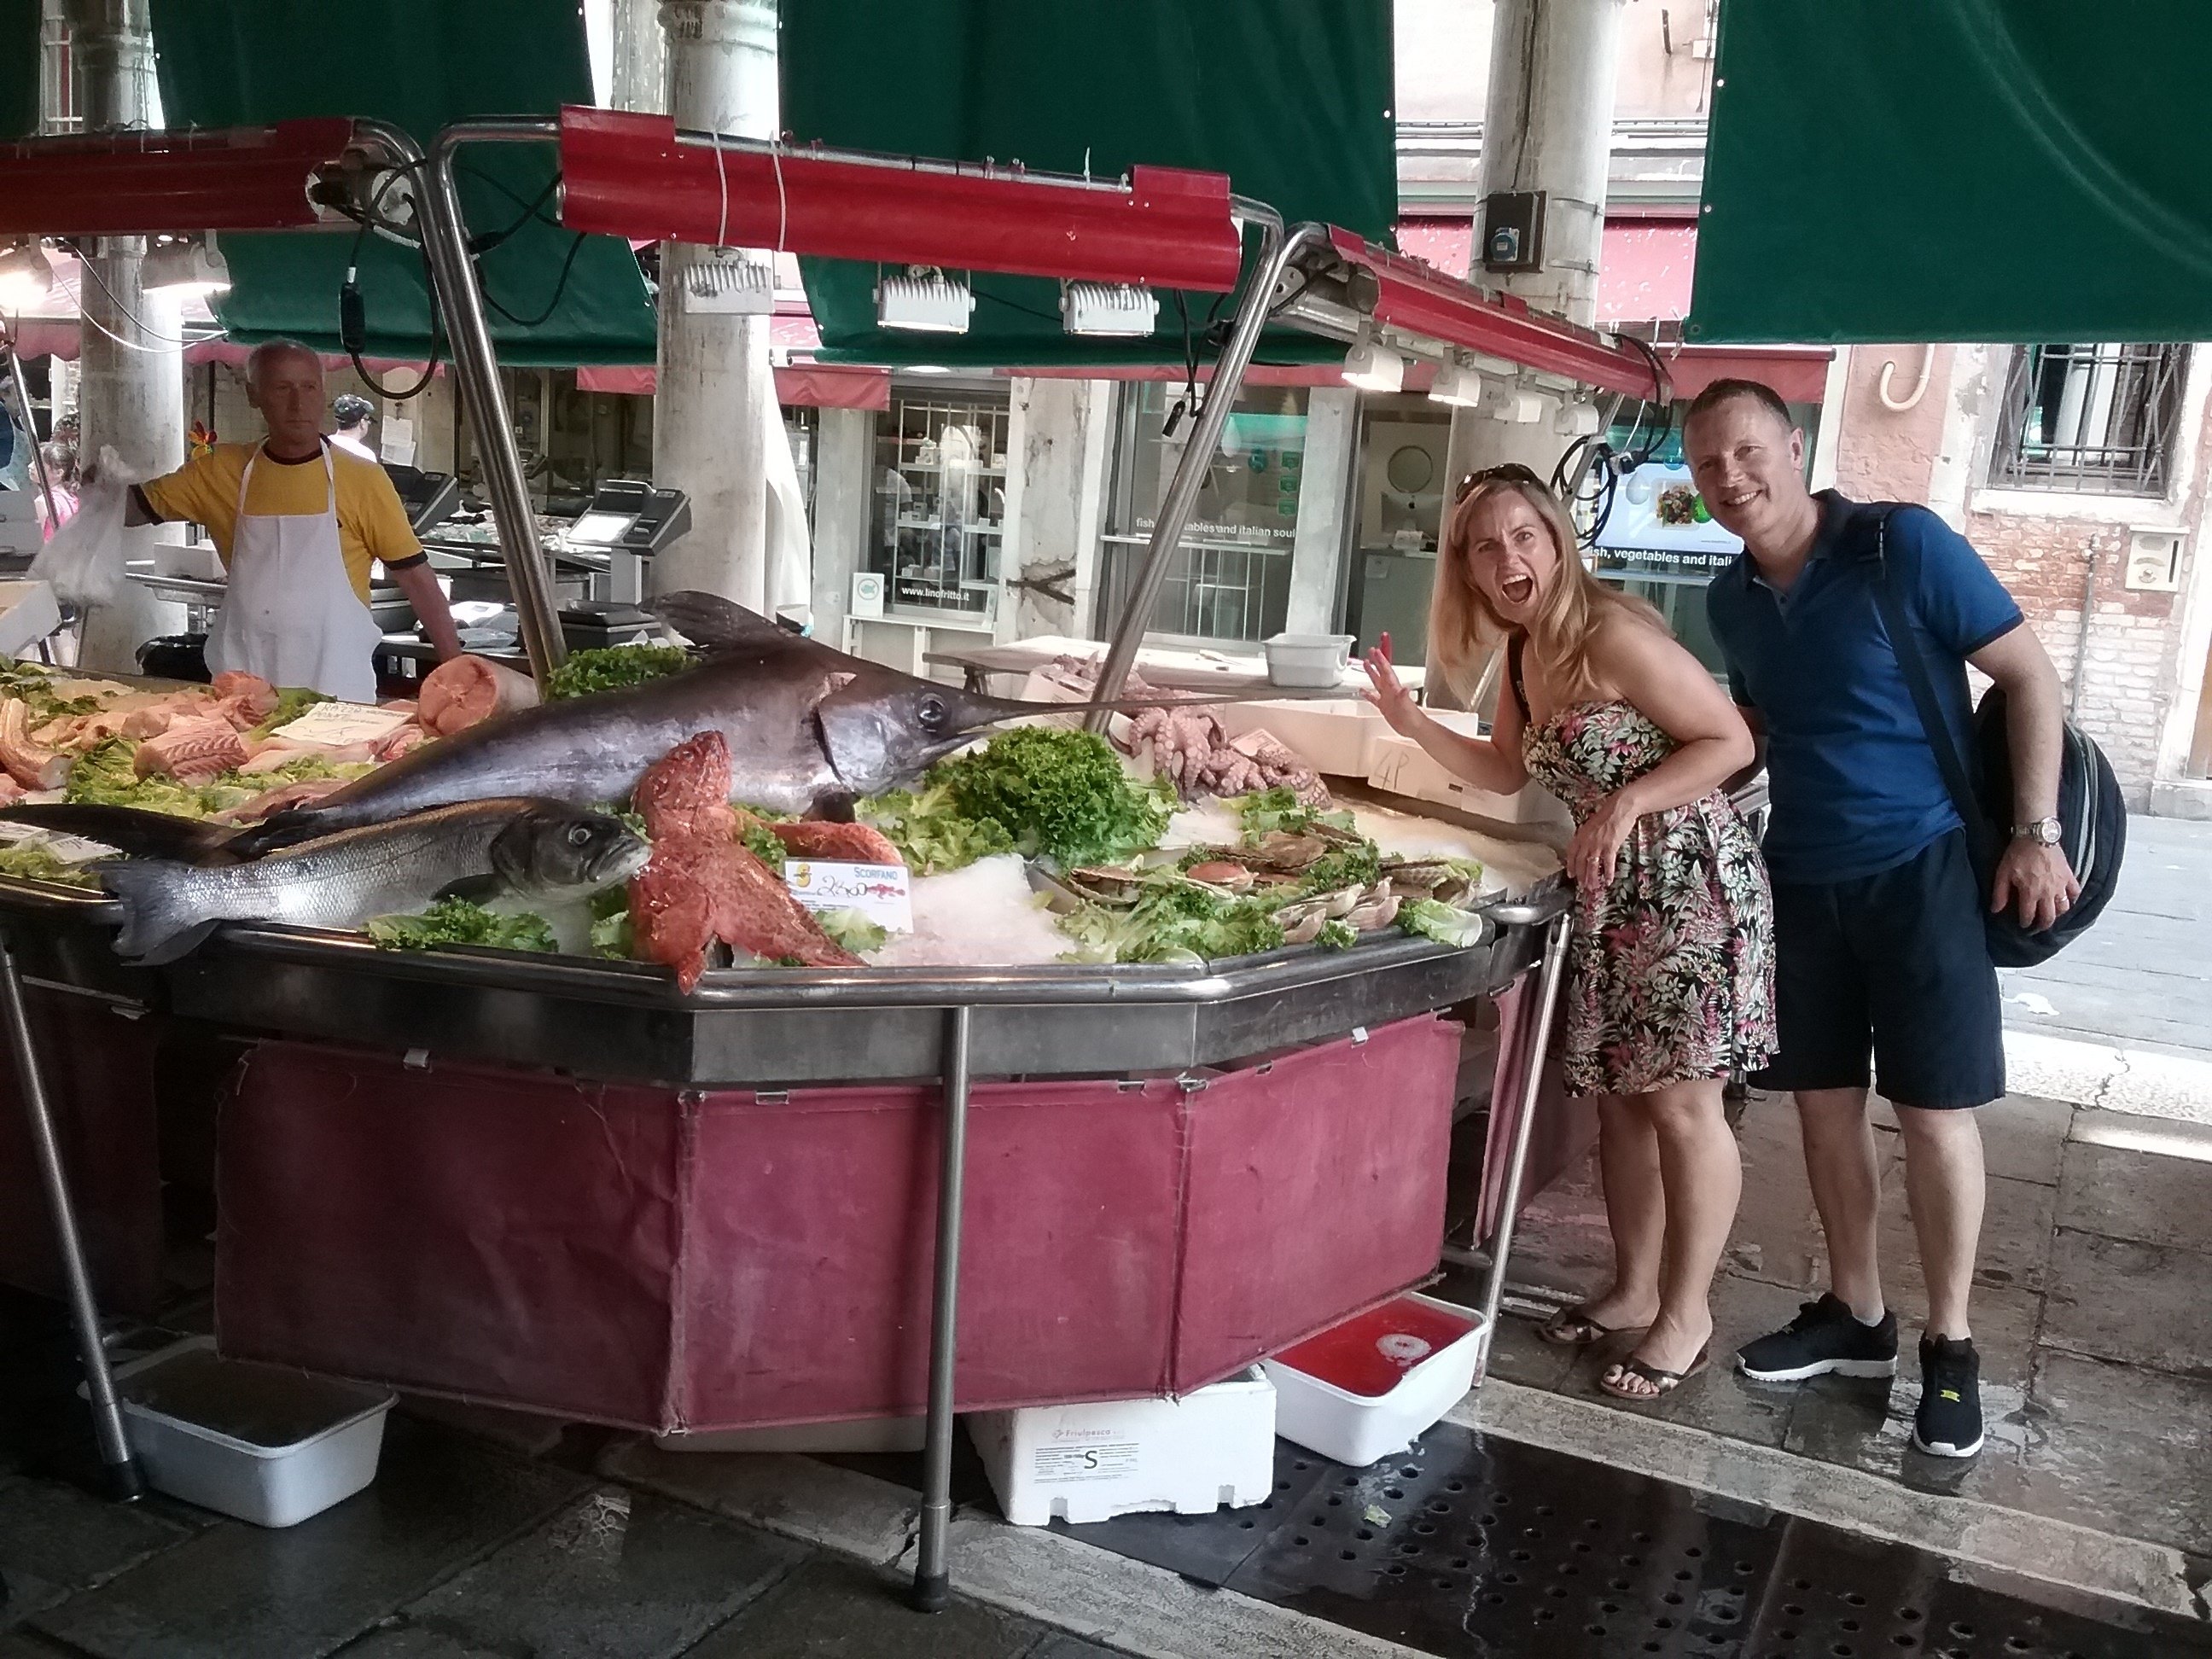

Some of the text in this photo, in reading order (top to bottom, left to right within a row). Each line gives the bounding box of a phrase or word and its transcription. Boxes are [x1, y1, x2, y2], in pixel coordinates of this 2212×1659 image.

[1136, 517, 1155, 528] fish
[1218, 524, 1237, 534] and
[1238, 525, 1271, 537] italian
[1272, 528, 1295, 538] soul
[1590, 546, 1732, 567] ish, vegetables and itali
[901, 586, 969, 601] www.linofritto.it
[1083, 1450, 1098, 1470] S
